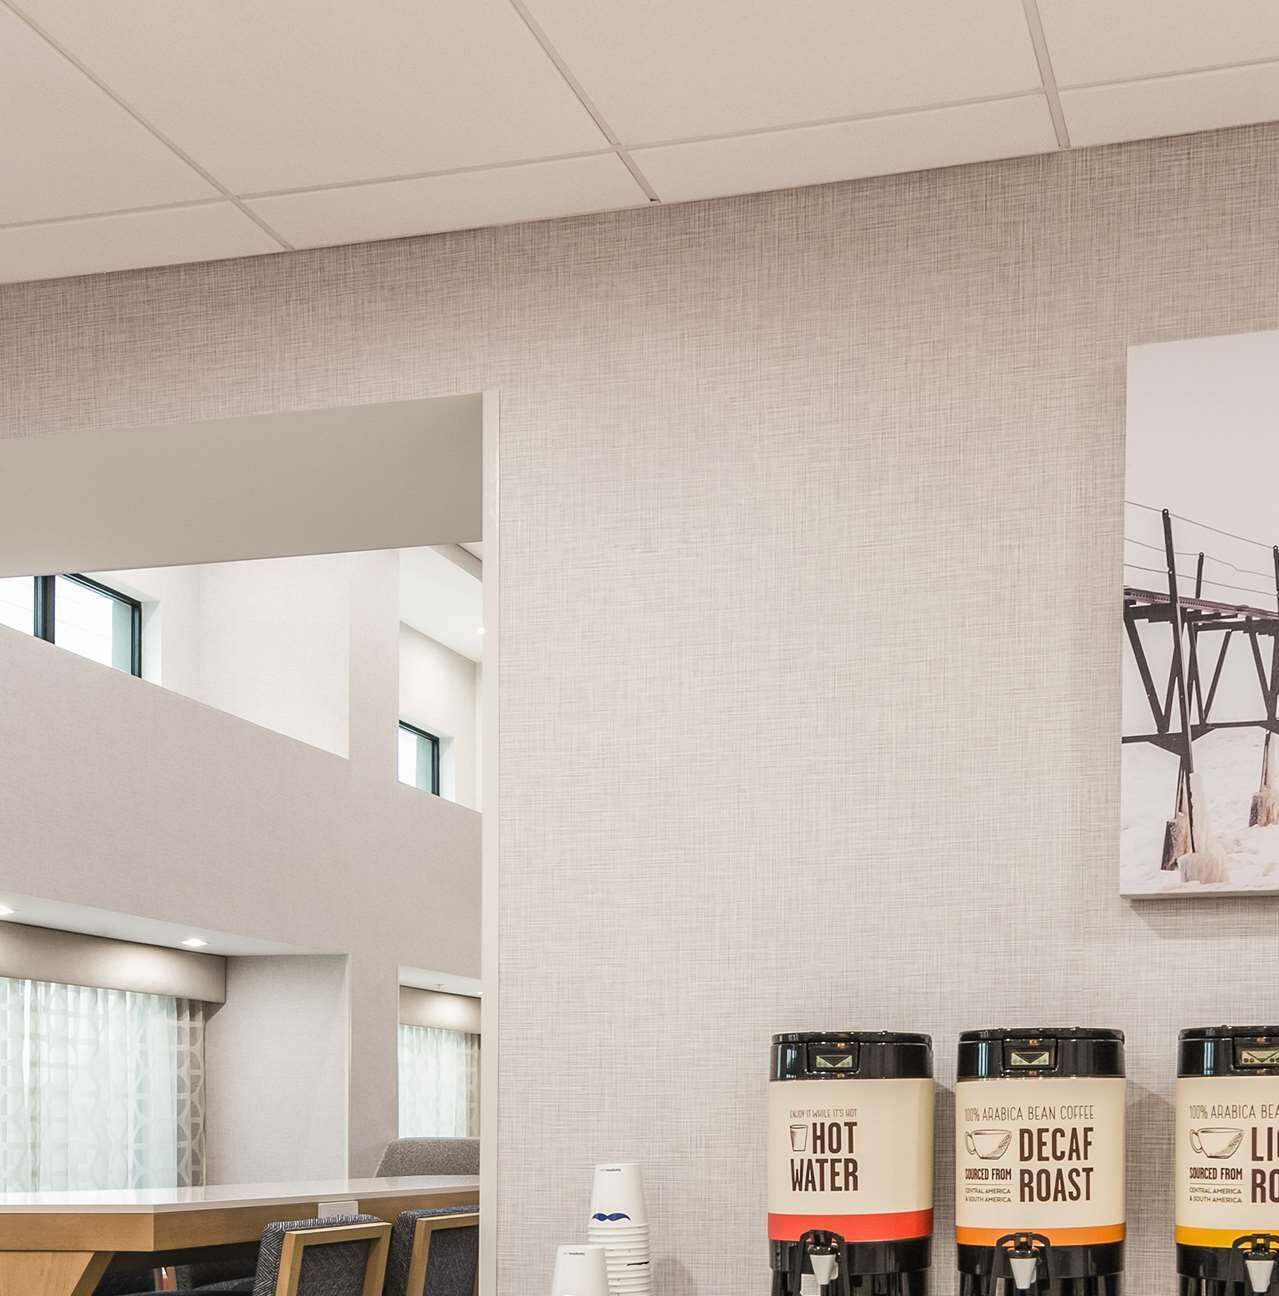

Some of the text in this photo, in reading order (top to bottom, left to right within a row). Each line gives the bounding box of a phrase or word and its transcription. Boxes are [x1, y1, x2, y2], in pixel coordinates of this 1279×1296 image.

[964, 1105, 1094, 1121] 100% ARABICA BEAN COFFEE
[1190, 1105, 1208, 1119] 100%
[1211, 1105, 1256, 1119] ARABICA
[812, 1122, 857, 1154] HOT
[1019, 1127, 1094, 1161] DECAF
[790, 1158, 858, 1191] WATER
[965, 1168, 1011, 1180] SOURCED FROM
[1019, 1167, 1094, 1202] ROAST
[1190, 1167, 1242, 1180] SOURCED FROM
